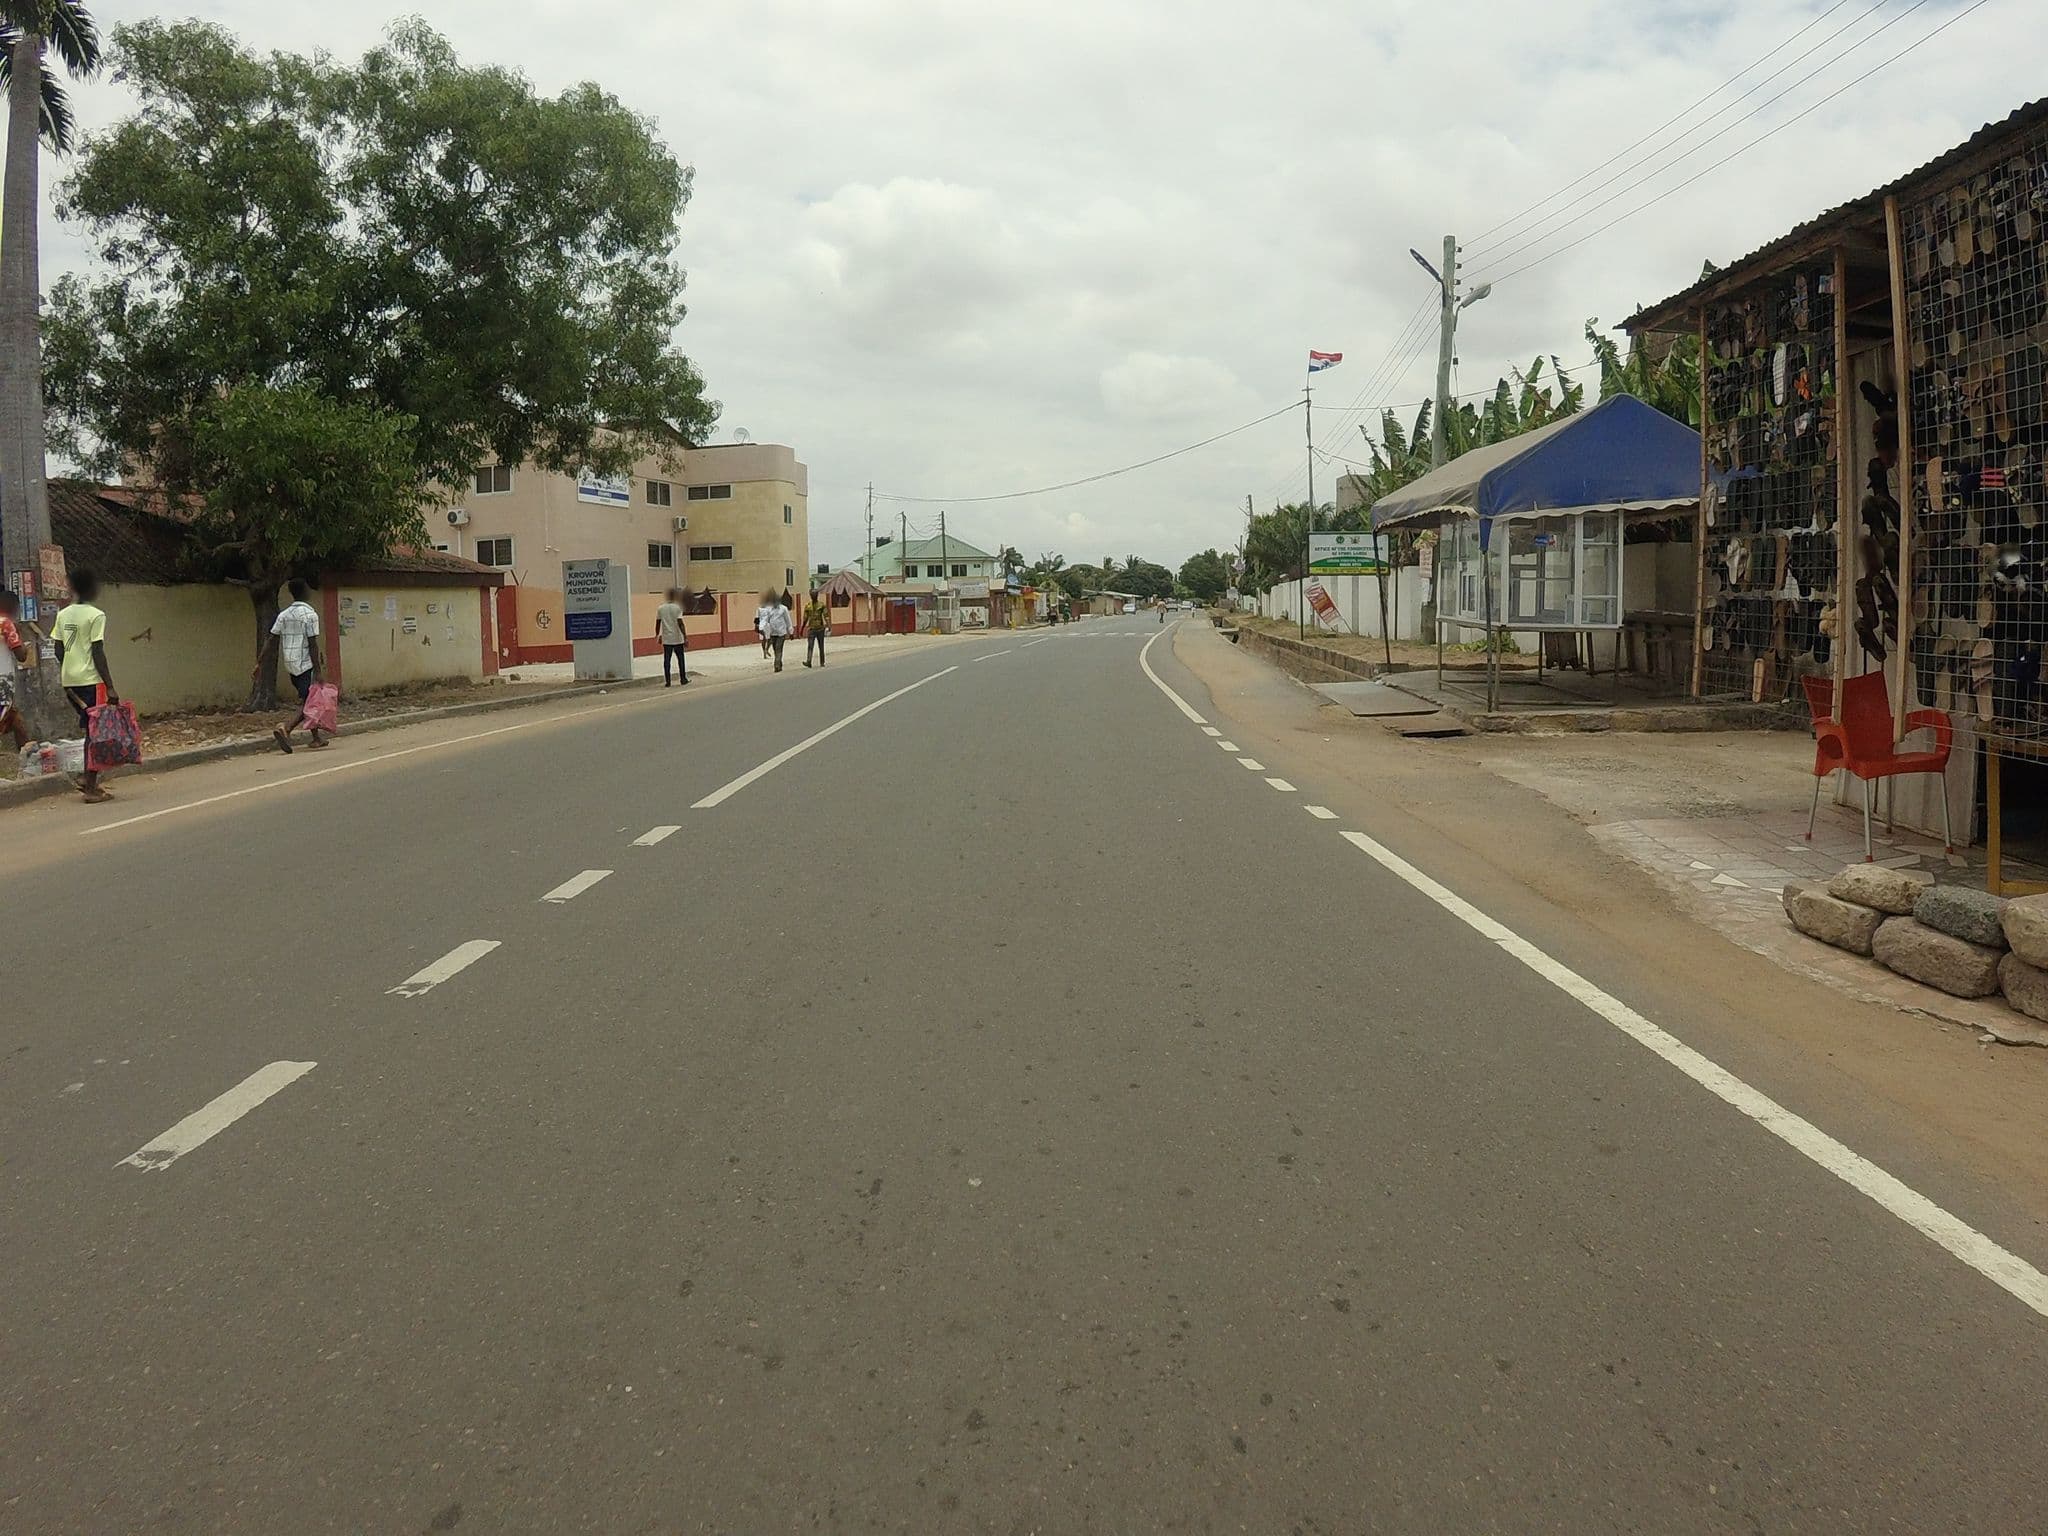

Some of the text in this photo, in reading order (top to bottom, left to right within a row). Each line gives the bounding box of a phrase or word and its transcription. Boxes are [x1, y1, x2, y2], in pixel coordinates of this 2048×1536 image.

[568, 570, 605, 579] KROWOR
[565, 578, 608, 587] MUNICIPAL
[567, 586, 607, 595] ASSEMBLY
[64, 623, 78, 652] 7
